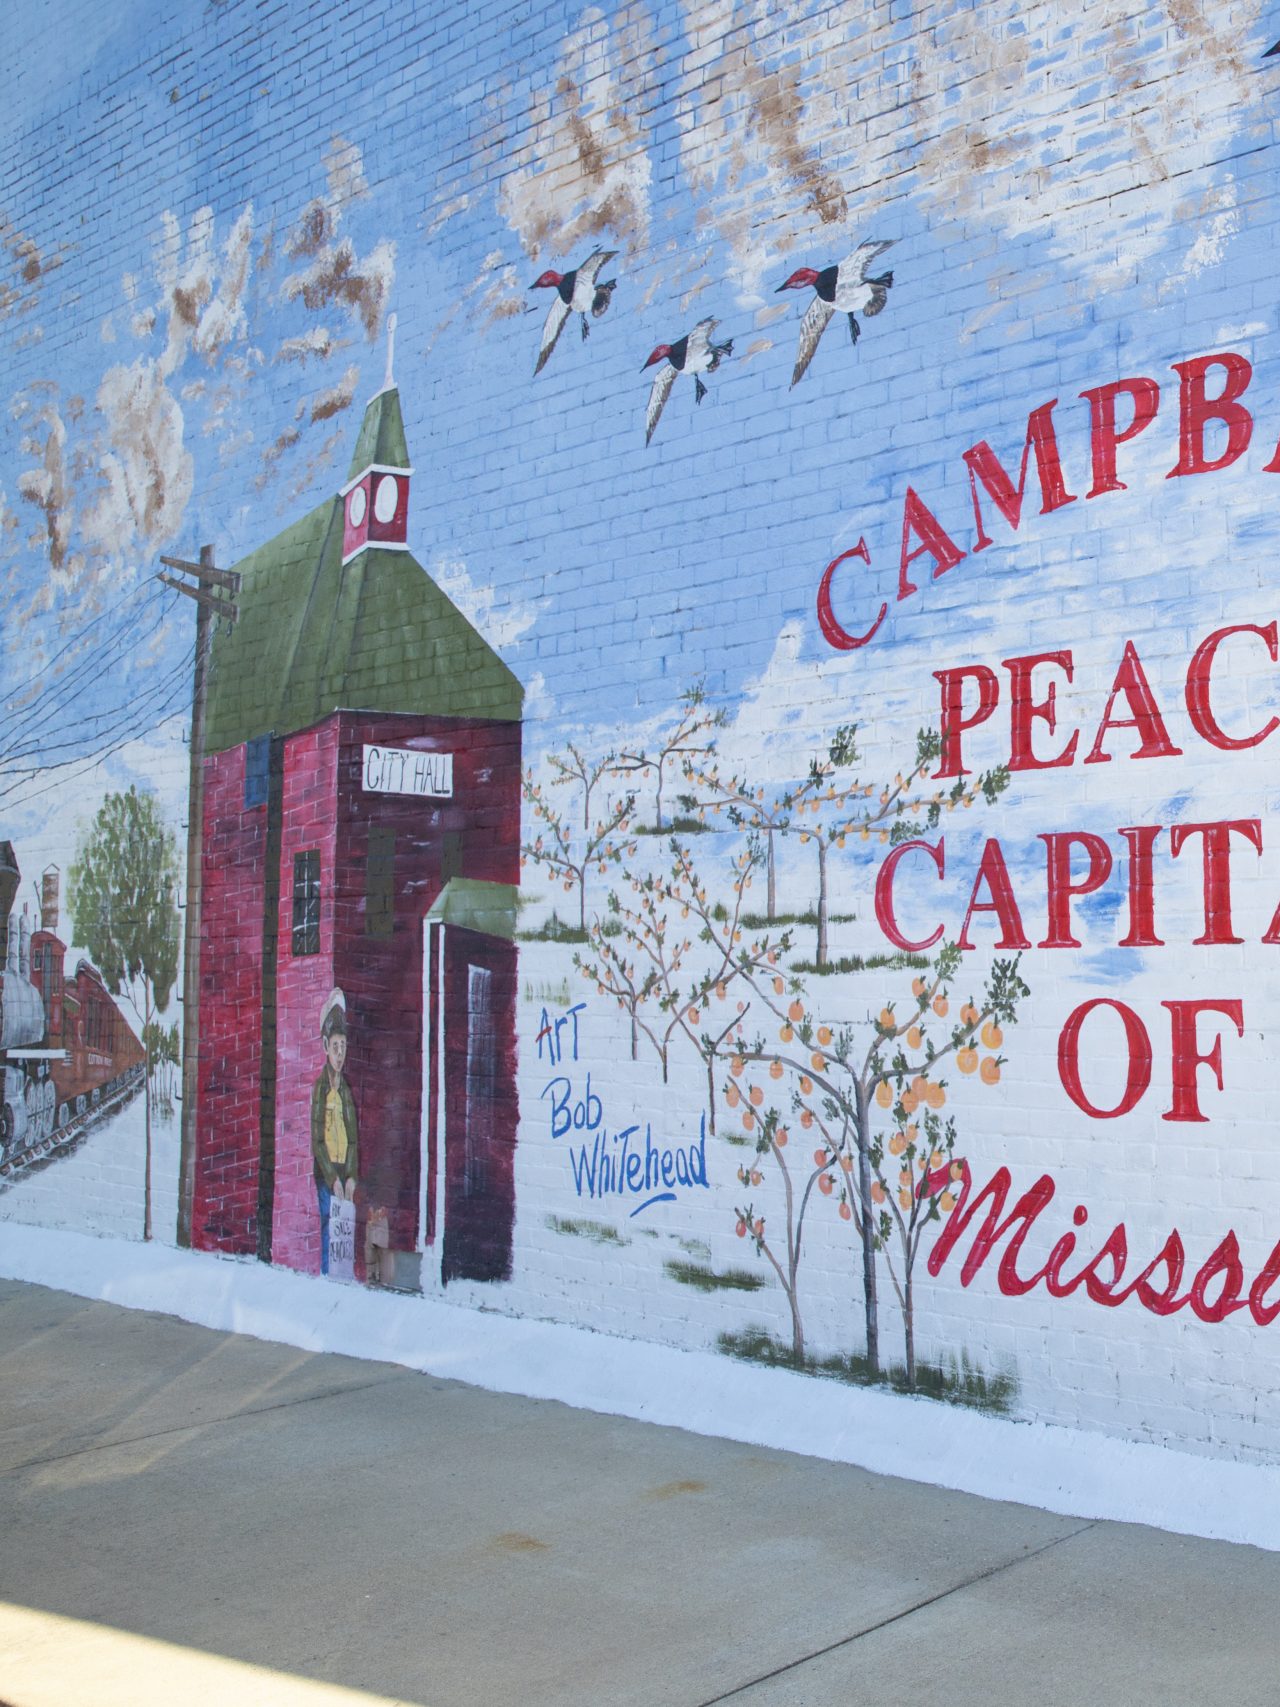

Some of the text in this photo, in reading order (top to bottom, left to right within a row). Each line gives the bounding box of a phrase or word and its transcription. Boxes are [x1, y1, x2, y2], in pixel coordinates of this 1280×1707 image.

[367, 748, 450, 795] CITY HALL
[1057, 997, 1244, 1123] OF
[540, 1072, 602, 1139] Bob
